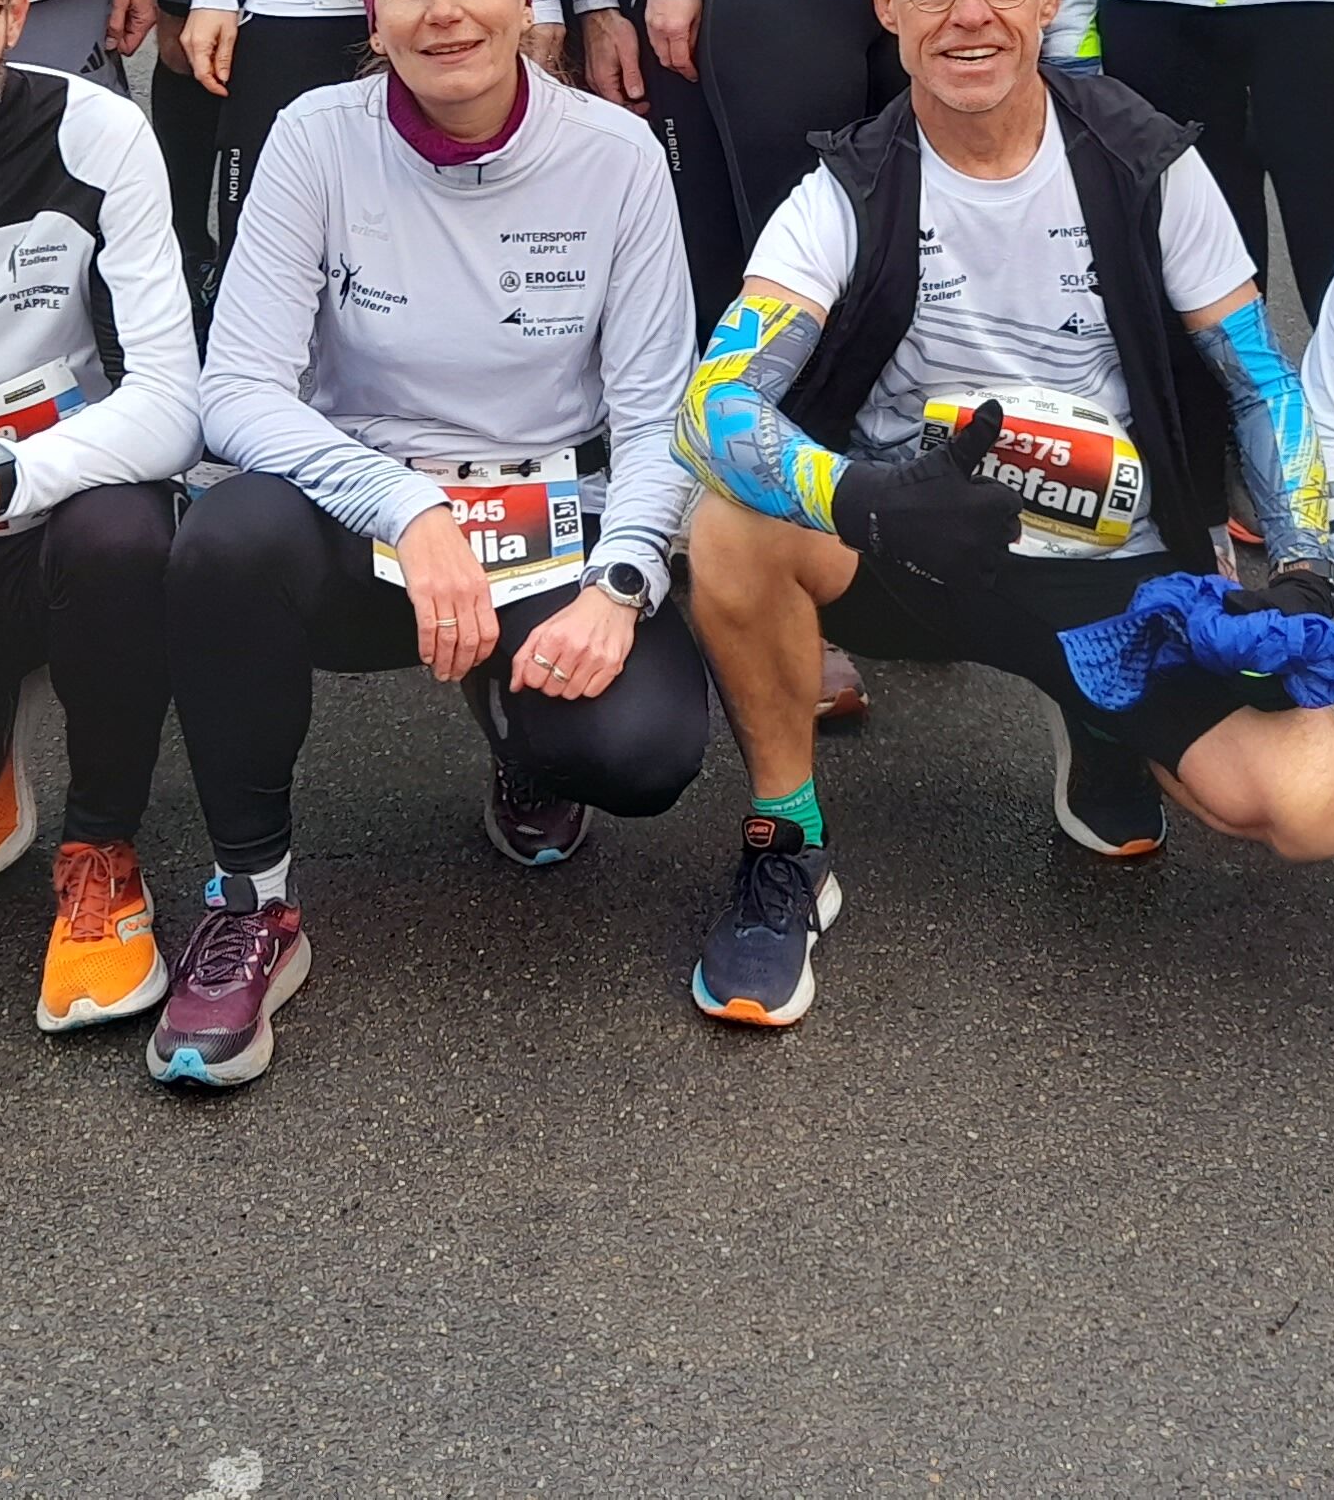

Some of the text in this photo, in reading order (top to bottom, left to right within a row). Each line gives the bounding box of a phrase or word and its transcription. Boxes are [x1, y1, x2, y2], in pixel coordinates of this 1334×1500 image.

[664, 118, 682, 172] FUSION
[228, 148, 241, 202] FUSION
[511, 231, 588, 244] INTERSPORT
[529, 244, 568, 255] RÄPPLE
[525, 270, 586, 284] EROGLU
[8, 285, 70, 301] INTERSPORT
[351, 280, 408, 306] Steinlach
[13, 298, 61, 312] RÄPPLE
[522, 324, 586, 338] MeTraVit
[999, 427, 1073, 468] 2375
[971, 452, 1100, 519] tefan
